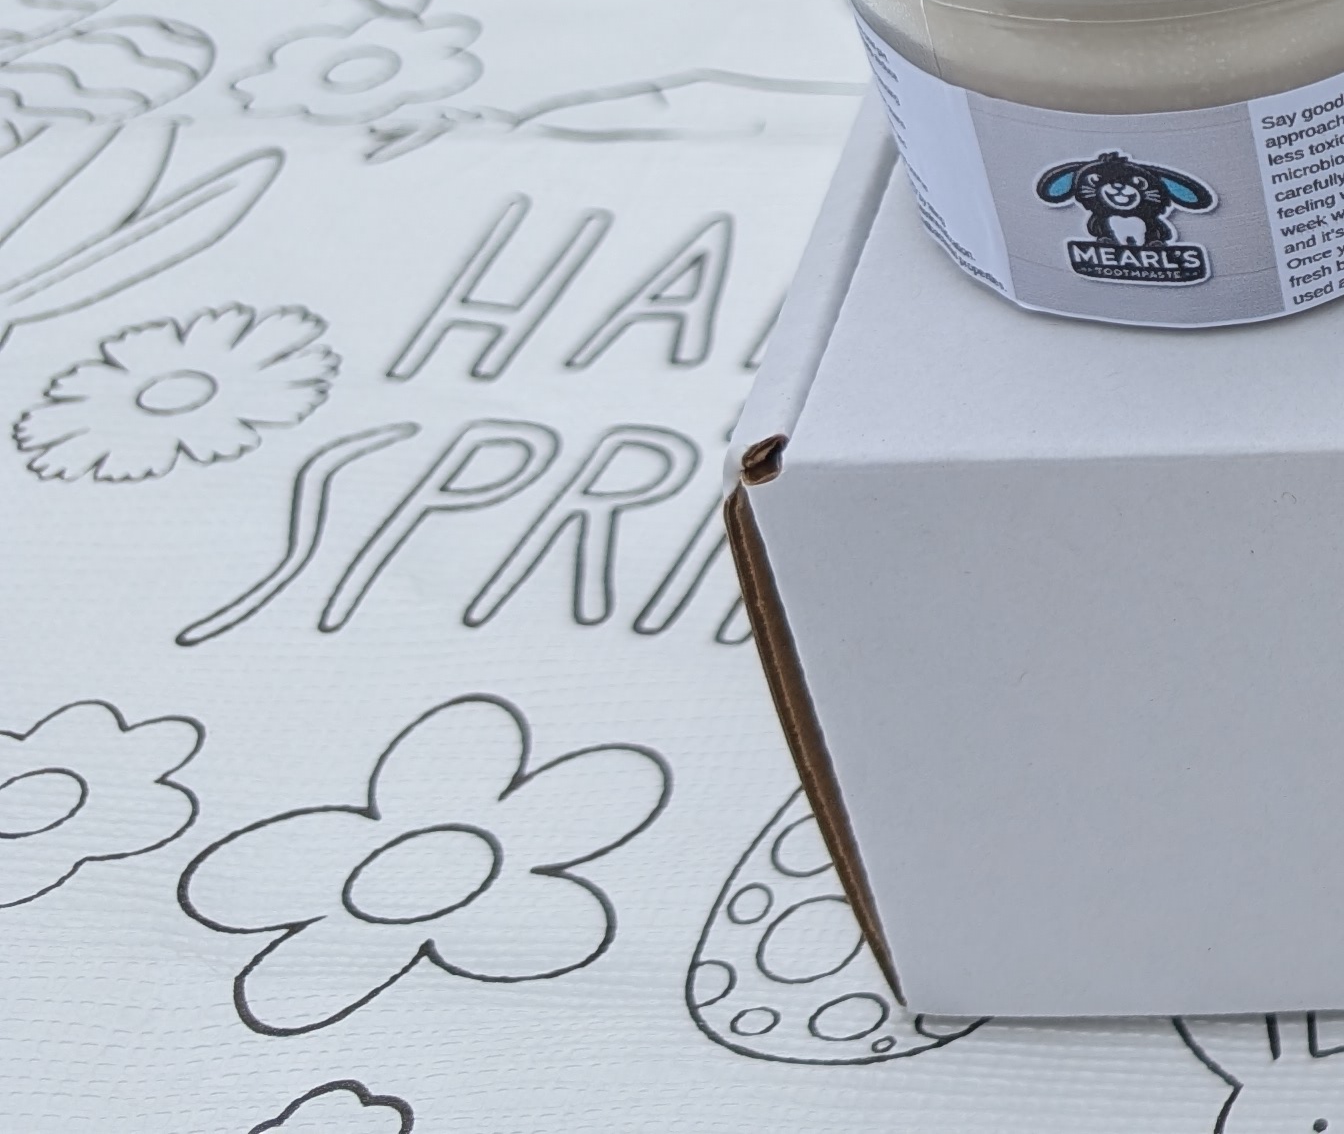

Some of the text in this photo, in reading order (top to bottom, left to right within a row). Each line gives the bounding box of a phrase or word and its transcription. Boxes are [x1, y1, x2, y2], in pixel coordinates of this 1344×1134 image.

[1261, 112, 1297, 129] Say
[1268, 149, 1305, 166] less
[1277, 194, 1336, 219] feeling
[1280, 215, 1328, 237] week
[1284, 234, 1317, 254] and
[1321, 227, 1344, 243] it's
[1072, 244, 1201, 269] MEARL'S
[1287, 248, 1332, 269] Once
[1095, 267, 1182, 279] TOOTHPASTE
[1289, 265, 1332, 288] fresh
[385, 193, 786, 382] HA
[1293, 281, 1334, 305] used
[174, 419, 757, 647] SPRI
